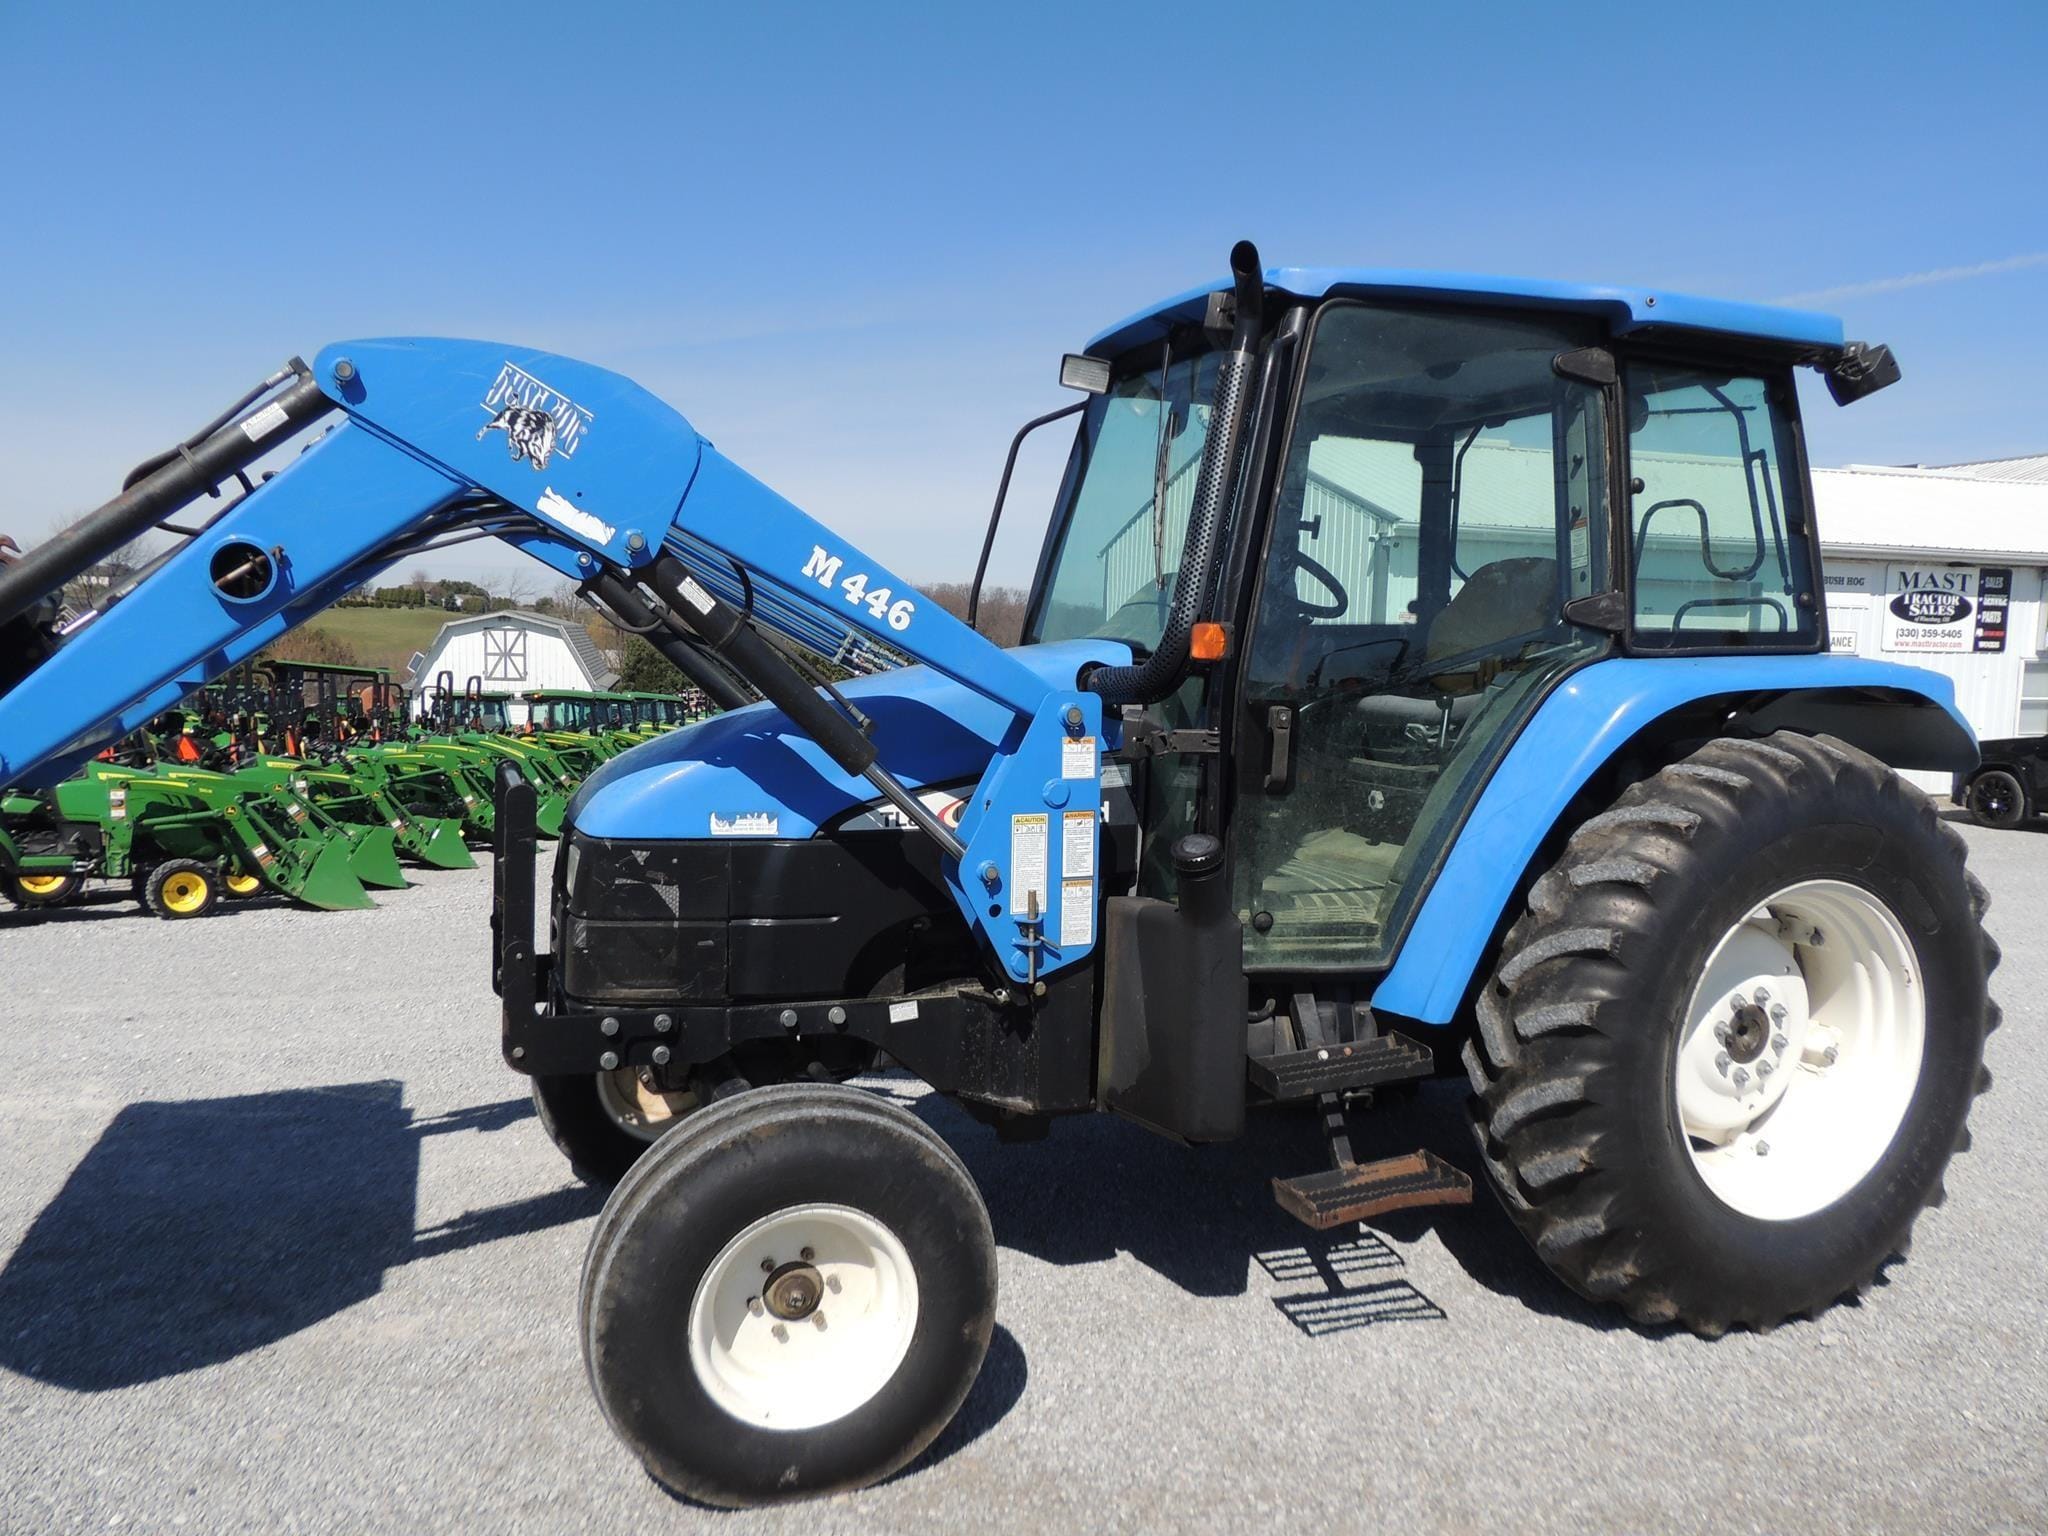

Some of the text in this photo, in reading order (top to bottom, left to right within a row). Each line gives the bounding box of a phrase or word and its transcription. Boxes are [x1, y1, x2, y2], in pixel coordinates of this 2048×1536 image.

[802, 544, 915, 631] M 446
[1847, 577, 1865, 586] HOG
[1898, 571, 1972, 593] MAST
[1904, 593, 1960, 606] TRACTOR
[1909, 604, 1955, 617] SALES
[1981, 611, 2002, 623] PARTS
[1896, 628, 1962, 639] (330) 359-5405
[1020, 816, 1045, 824] CAUTION
